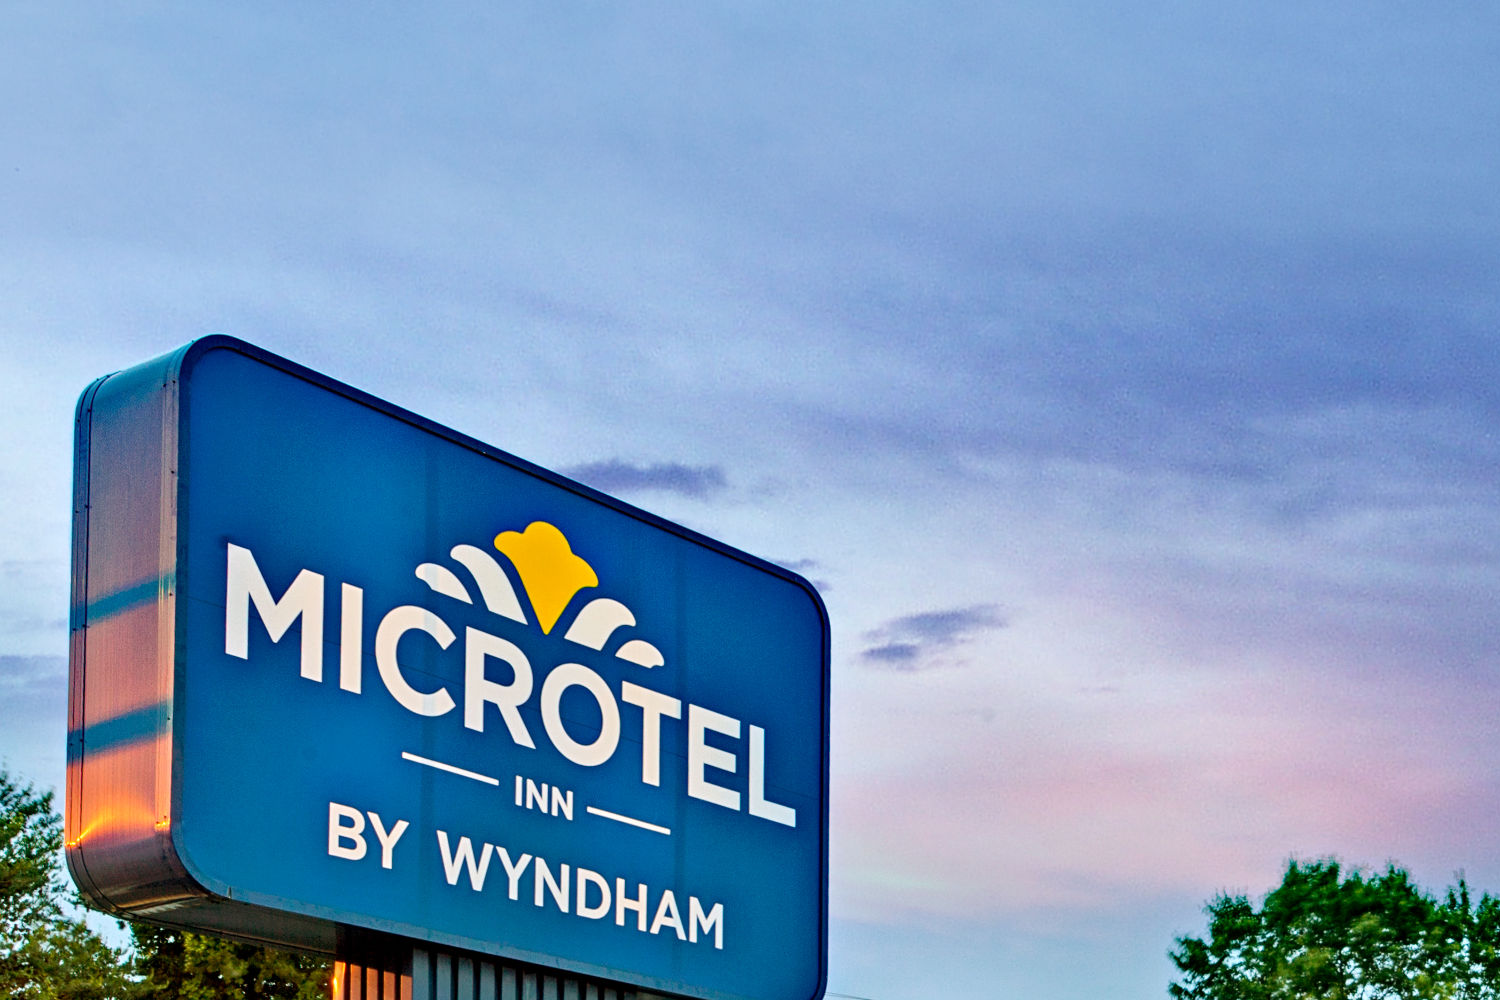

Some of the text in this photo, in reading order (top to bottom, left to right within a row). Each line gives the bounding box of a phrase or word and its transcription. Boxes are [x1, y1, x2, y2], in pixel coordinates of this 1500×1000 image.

[225, 543, 796, 828] MICROTEL
[515, 776, 574, 821] INN
[328, 802, 724, 950] BY WYNDHAM
